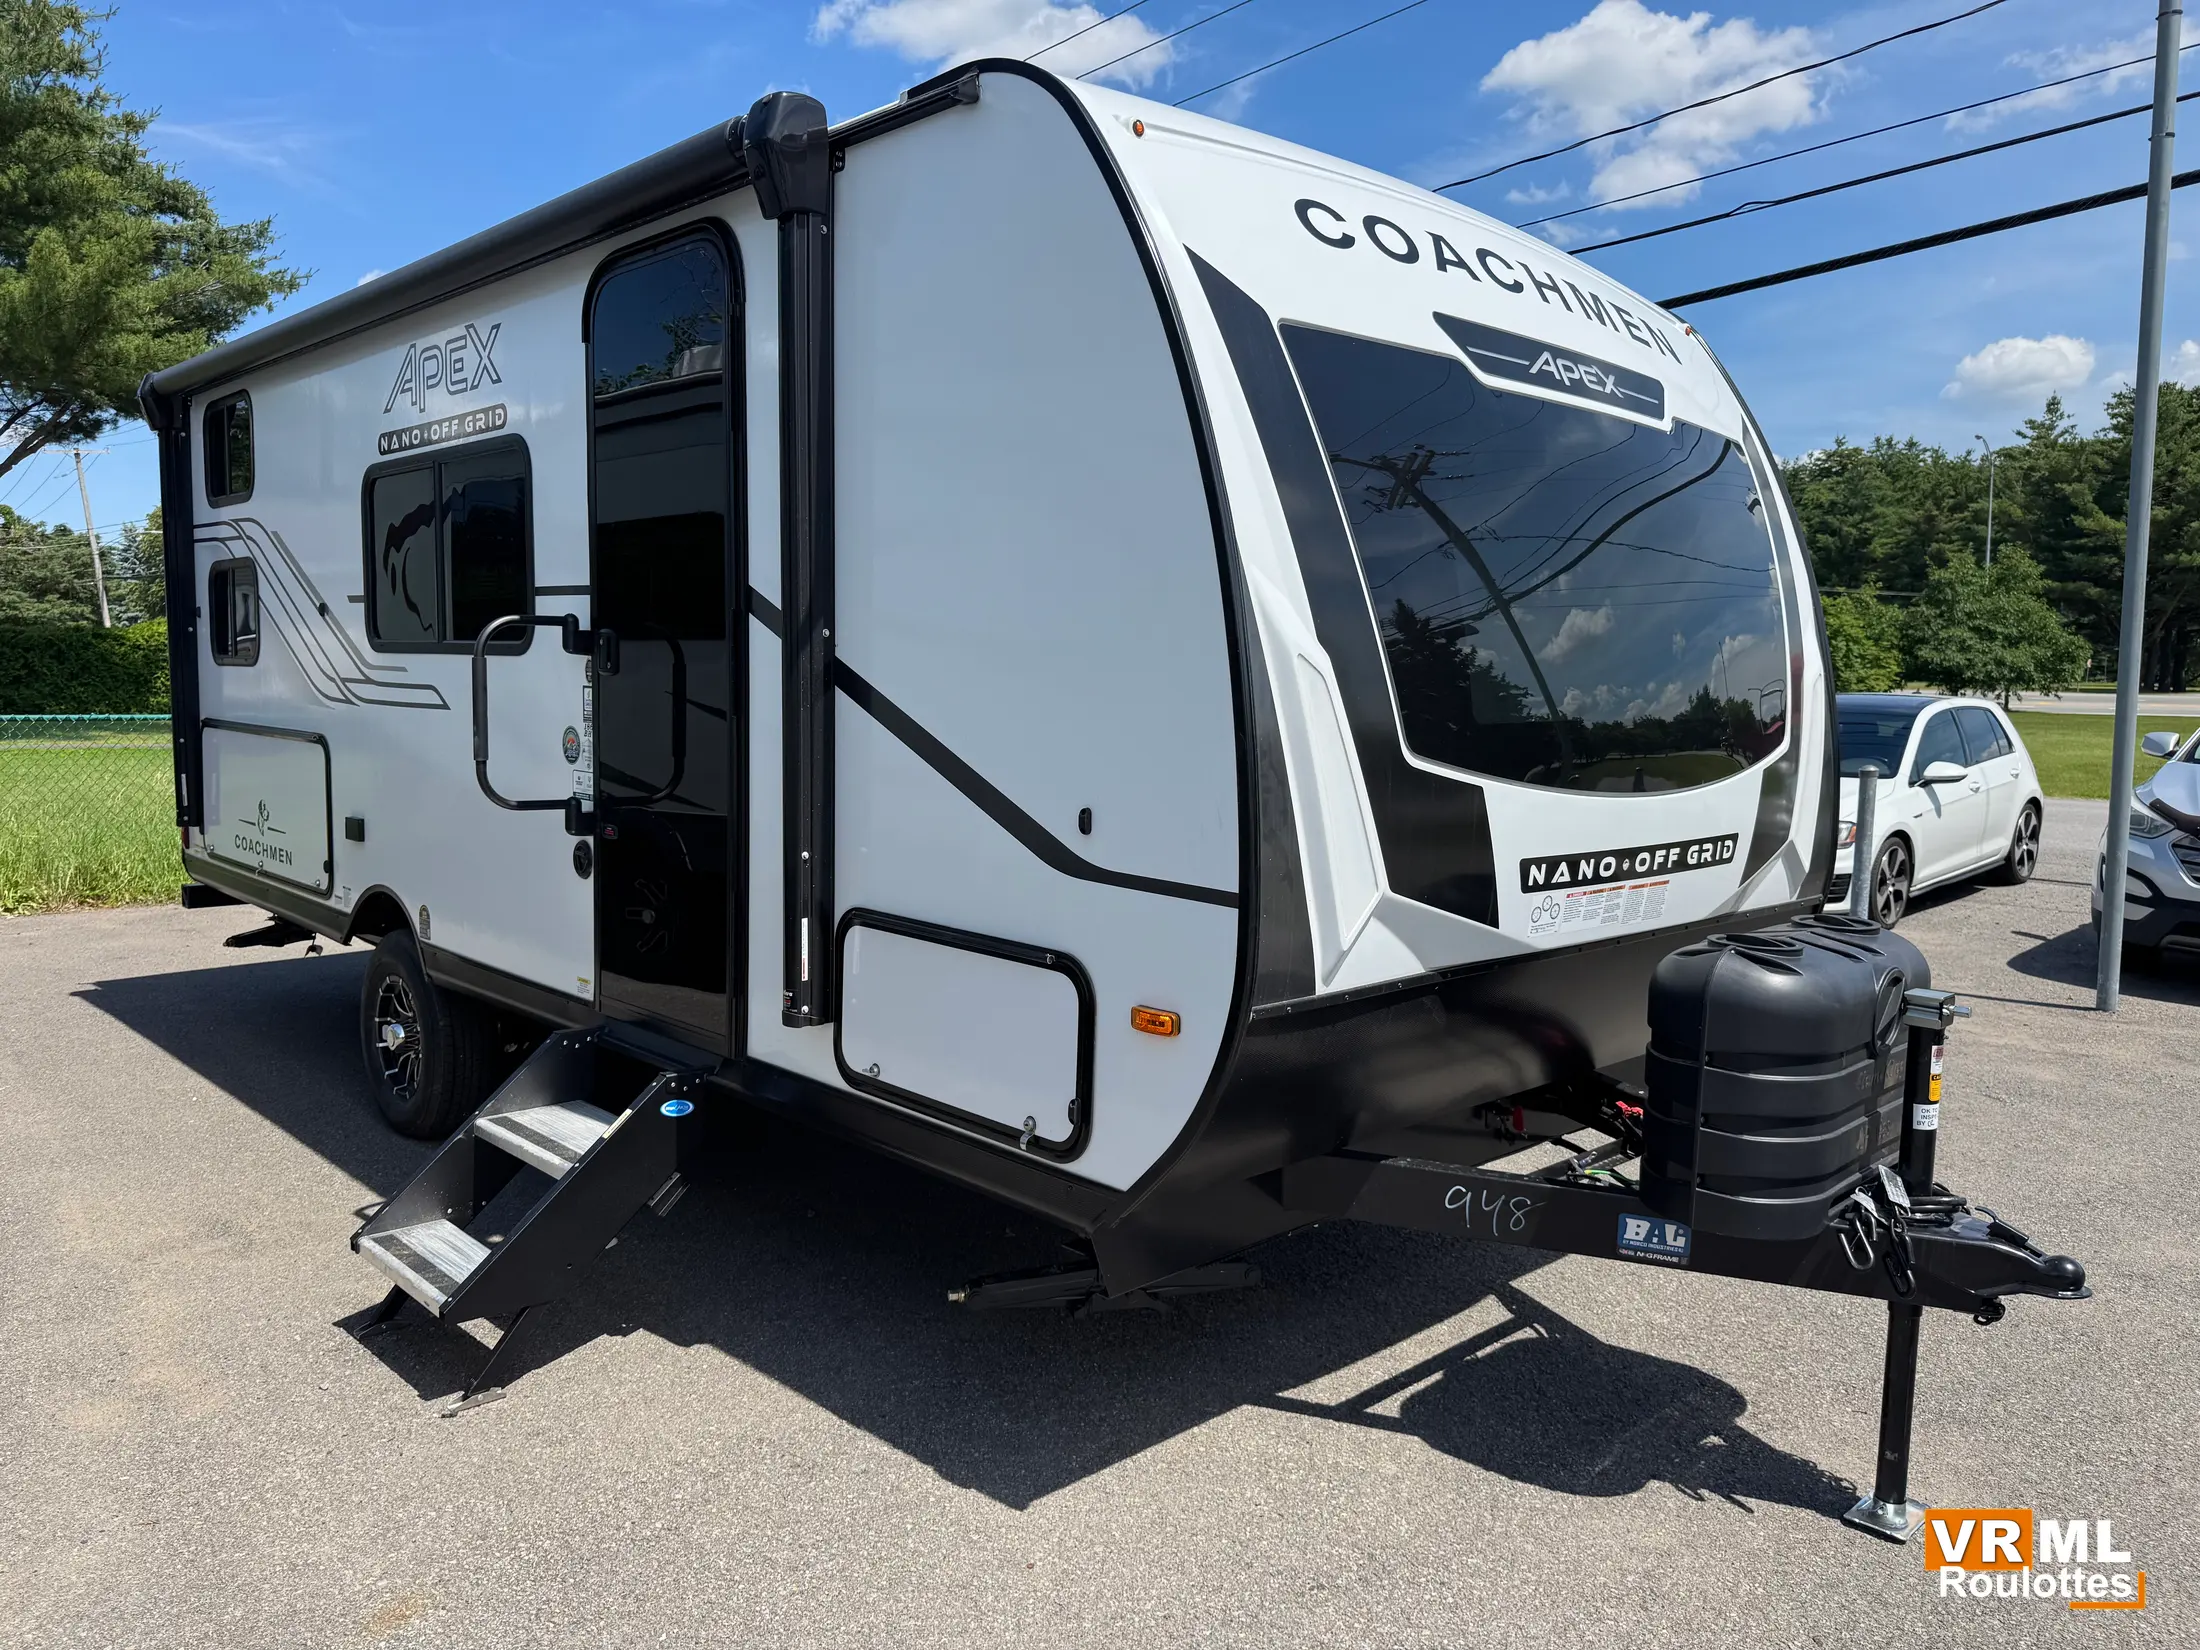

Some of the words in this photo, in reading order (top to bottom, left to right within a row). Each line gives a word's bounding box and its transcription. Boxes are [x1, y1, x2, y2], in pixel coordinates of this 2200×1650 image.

[1293, 198, 1683, 366] COACHMEN
[382, 322, 503, 414] APEX
[1528, 351, 1624, 399] APEX
[380, 429, 421, 452] NANO
[430, 419, 459, 440] OFF
[464, 408, 505, 433] GRID
[234, 834, 292, 866] COACHMEN
[1527, 856, 1617, 887] NANO
[1634, 847, 1681, 873] OFF
[1686, 839, 1734, 865] GRID
